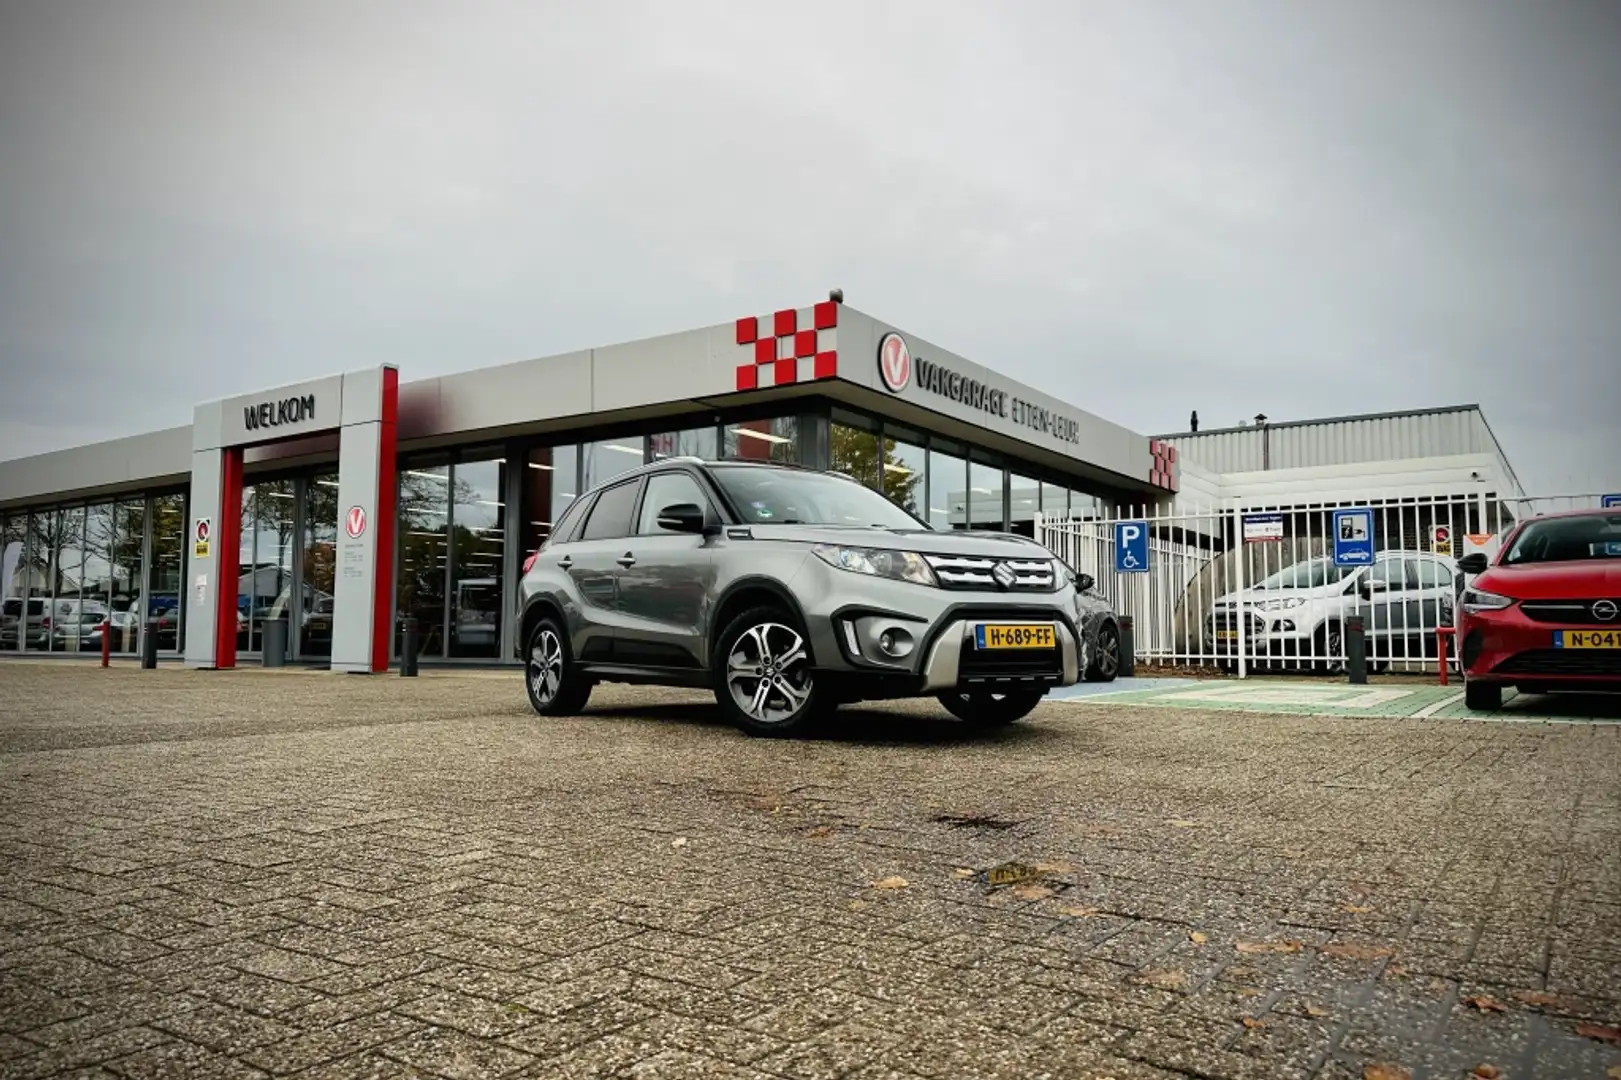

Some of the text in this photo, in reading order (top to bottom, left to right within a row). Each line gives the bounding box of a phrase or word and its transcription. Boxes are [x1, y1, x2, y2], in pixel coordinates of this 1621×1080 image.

[915, 357, 1008, 418] VAKGARAGE
[244, 393, 315, 431] WELKOM
[1122, 525, 1140, 549] P
[990, 628, 1051, 646] H-689-FF
